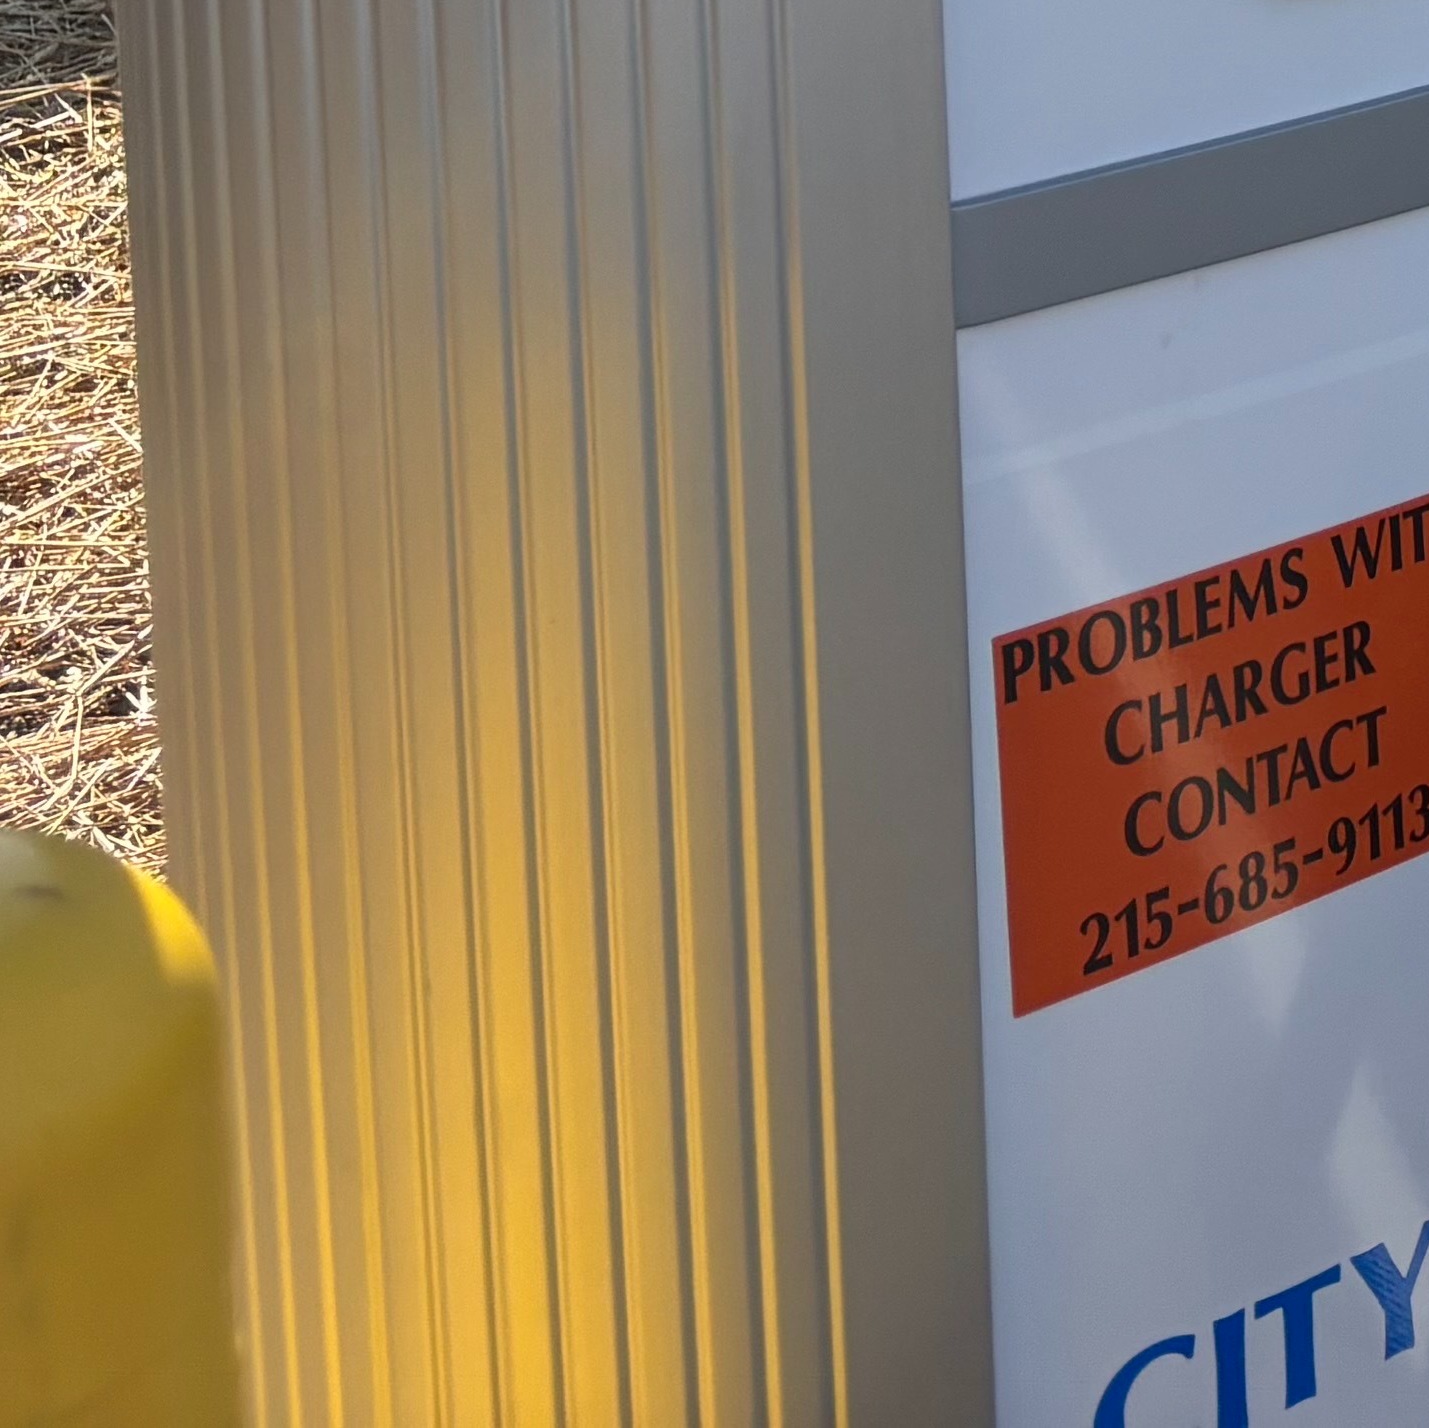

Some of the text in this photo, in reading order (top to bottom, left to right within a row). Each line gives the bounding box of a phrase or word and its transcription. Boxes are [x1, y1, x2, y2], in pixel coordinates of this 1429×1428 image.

[1001, 548, 1309, 705] PROBLEMS
[1104, 621, 1377, 766] CHARGER
[1124, 706, 1388, 857] CONTACT
